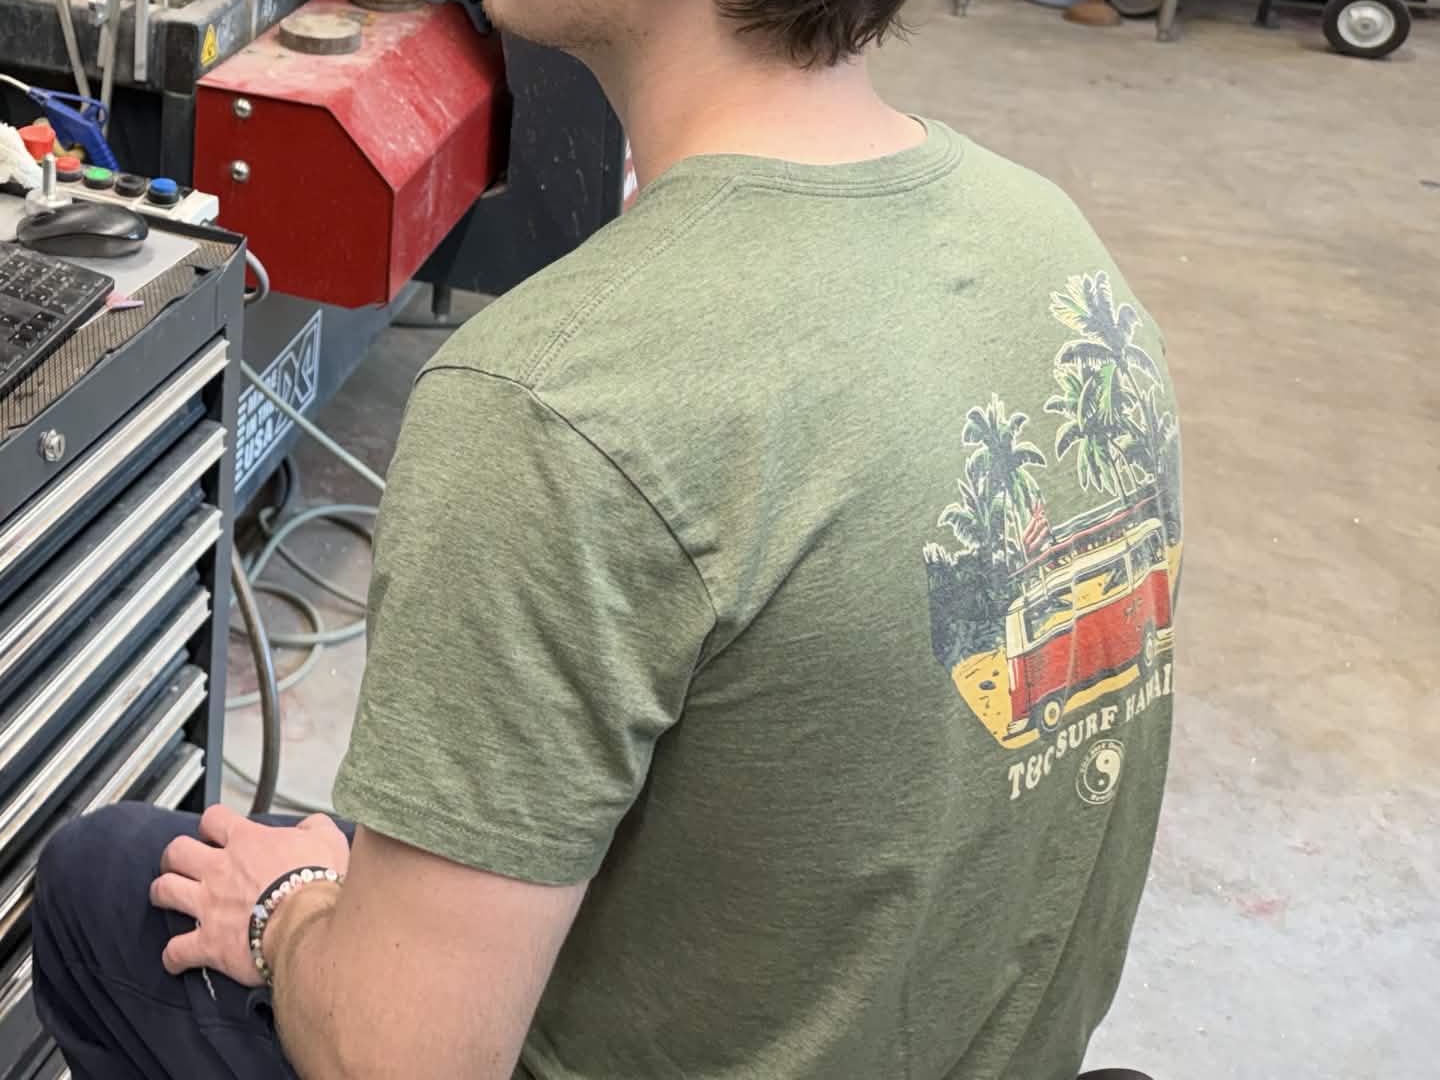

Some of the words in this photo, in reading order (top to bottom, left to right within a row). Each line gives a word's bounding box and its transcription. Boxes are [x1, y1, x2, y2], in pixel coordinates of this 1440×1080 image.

[243, 418, 274, 470] USA
[1008, 745, 1055, 800] T&C
[1056, 705, 1119, 759] SURF
[1125, 663, 1176, 722] HAWAI
